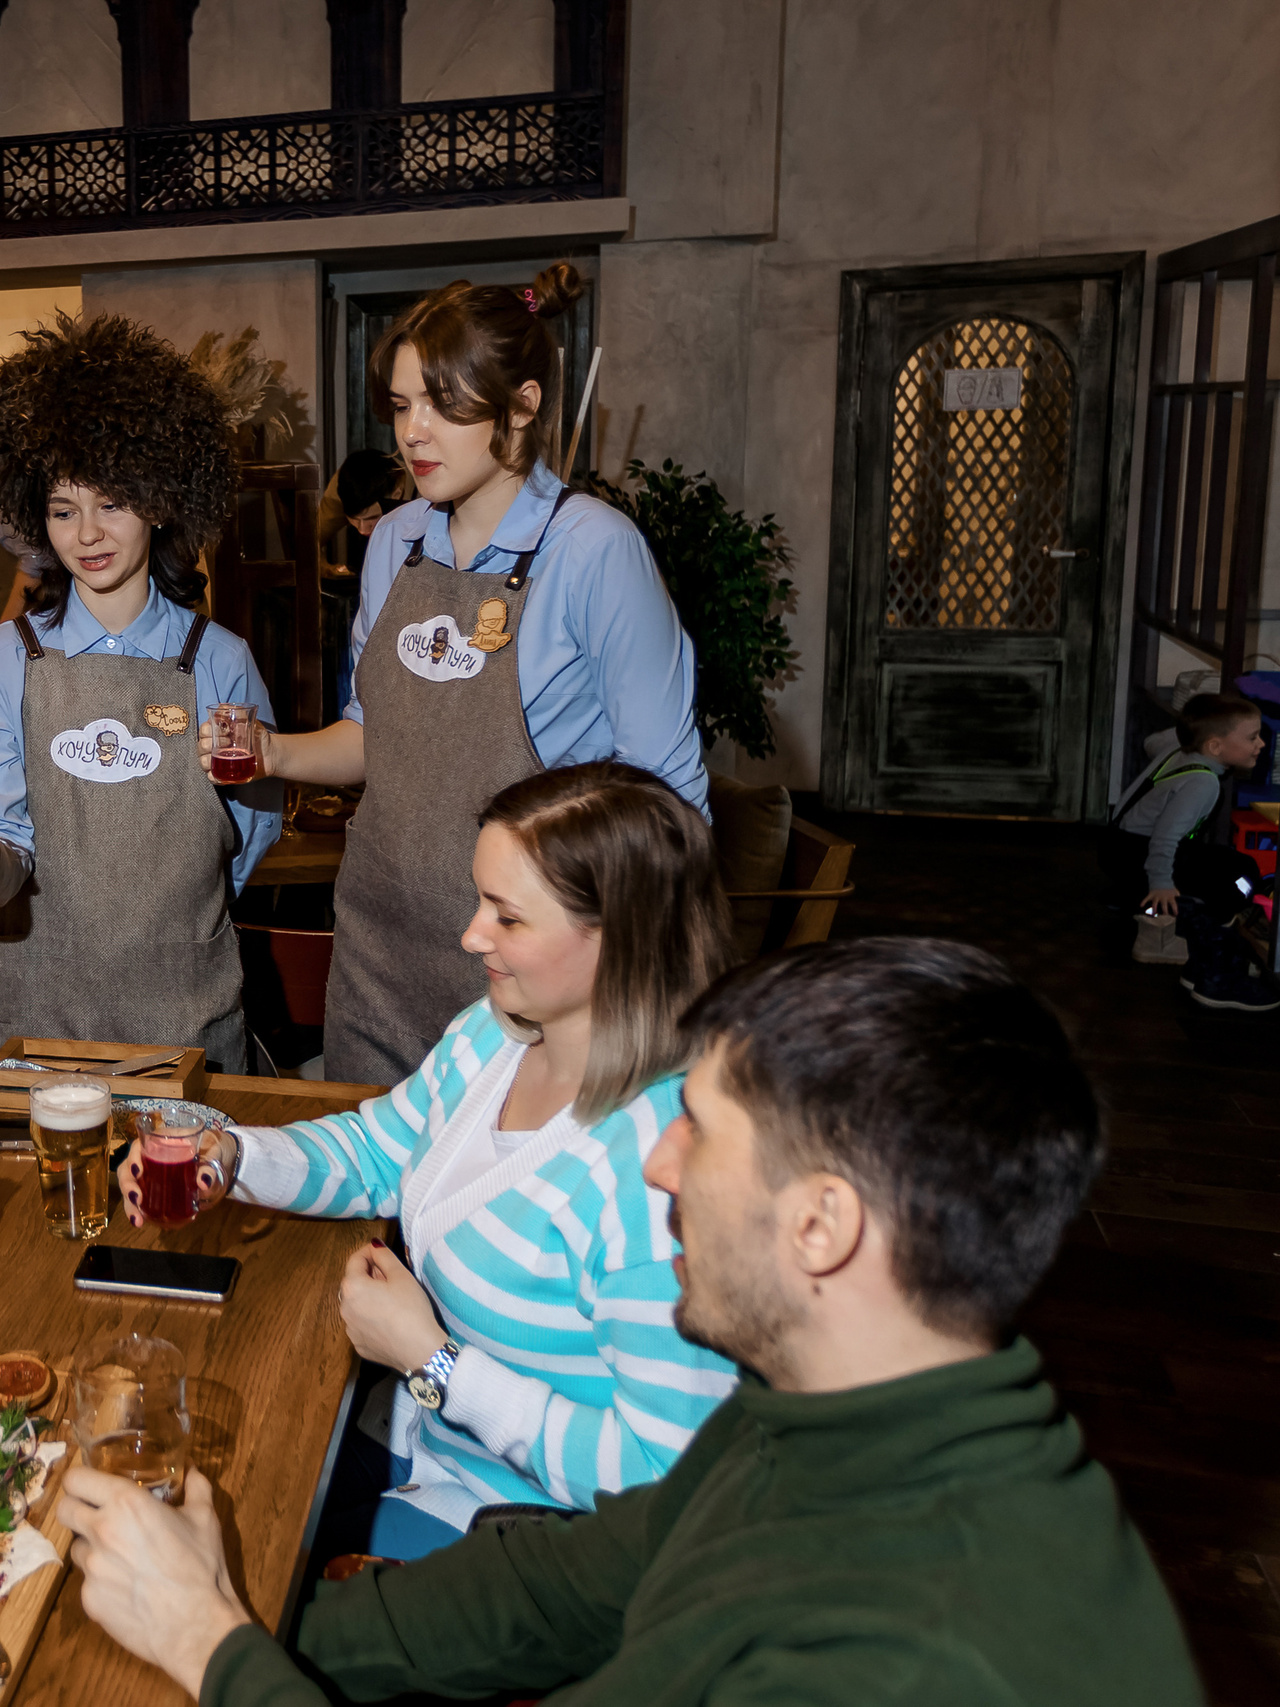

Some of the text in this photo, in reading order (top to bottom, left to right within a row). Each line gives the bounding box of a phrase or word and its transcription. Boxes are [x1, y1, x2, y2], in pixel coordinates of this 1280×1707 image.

[401, 633, 477, 673] ХОЧУ ПУРИ
[57, 740, 153, 771] ХОЧУ ПУРИ
